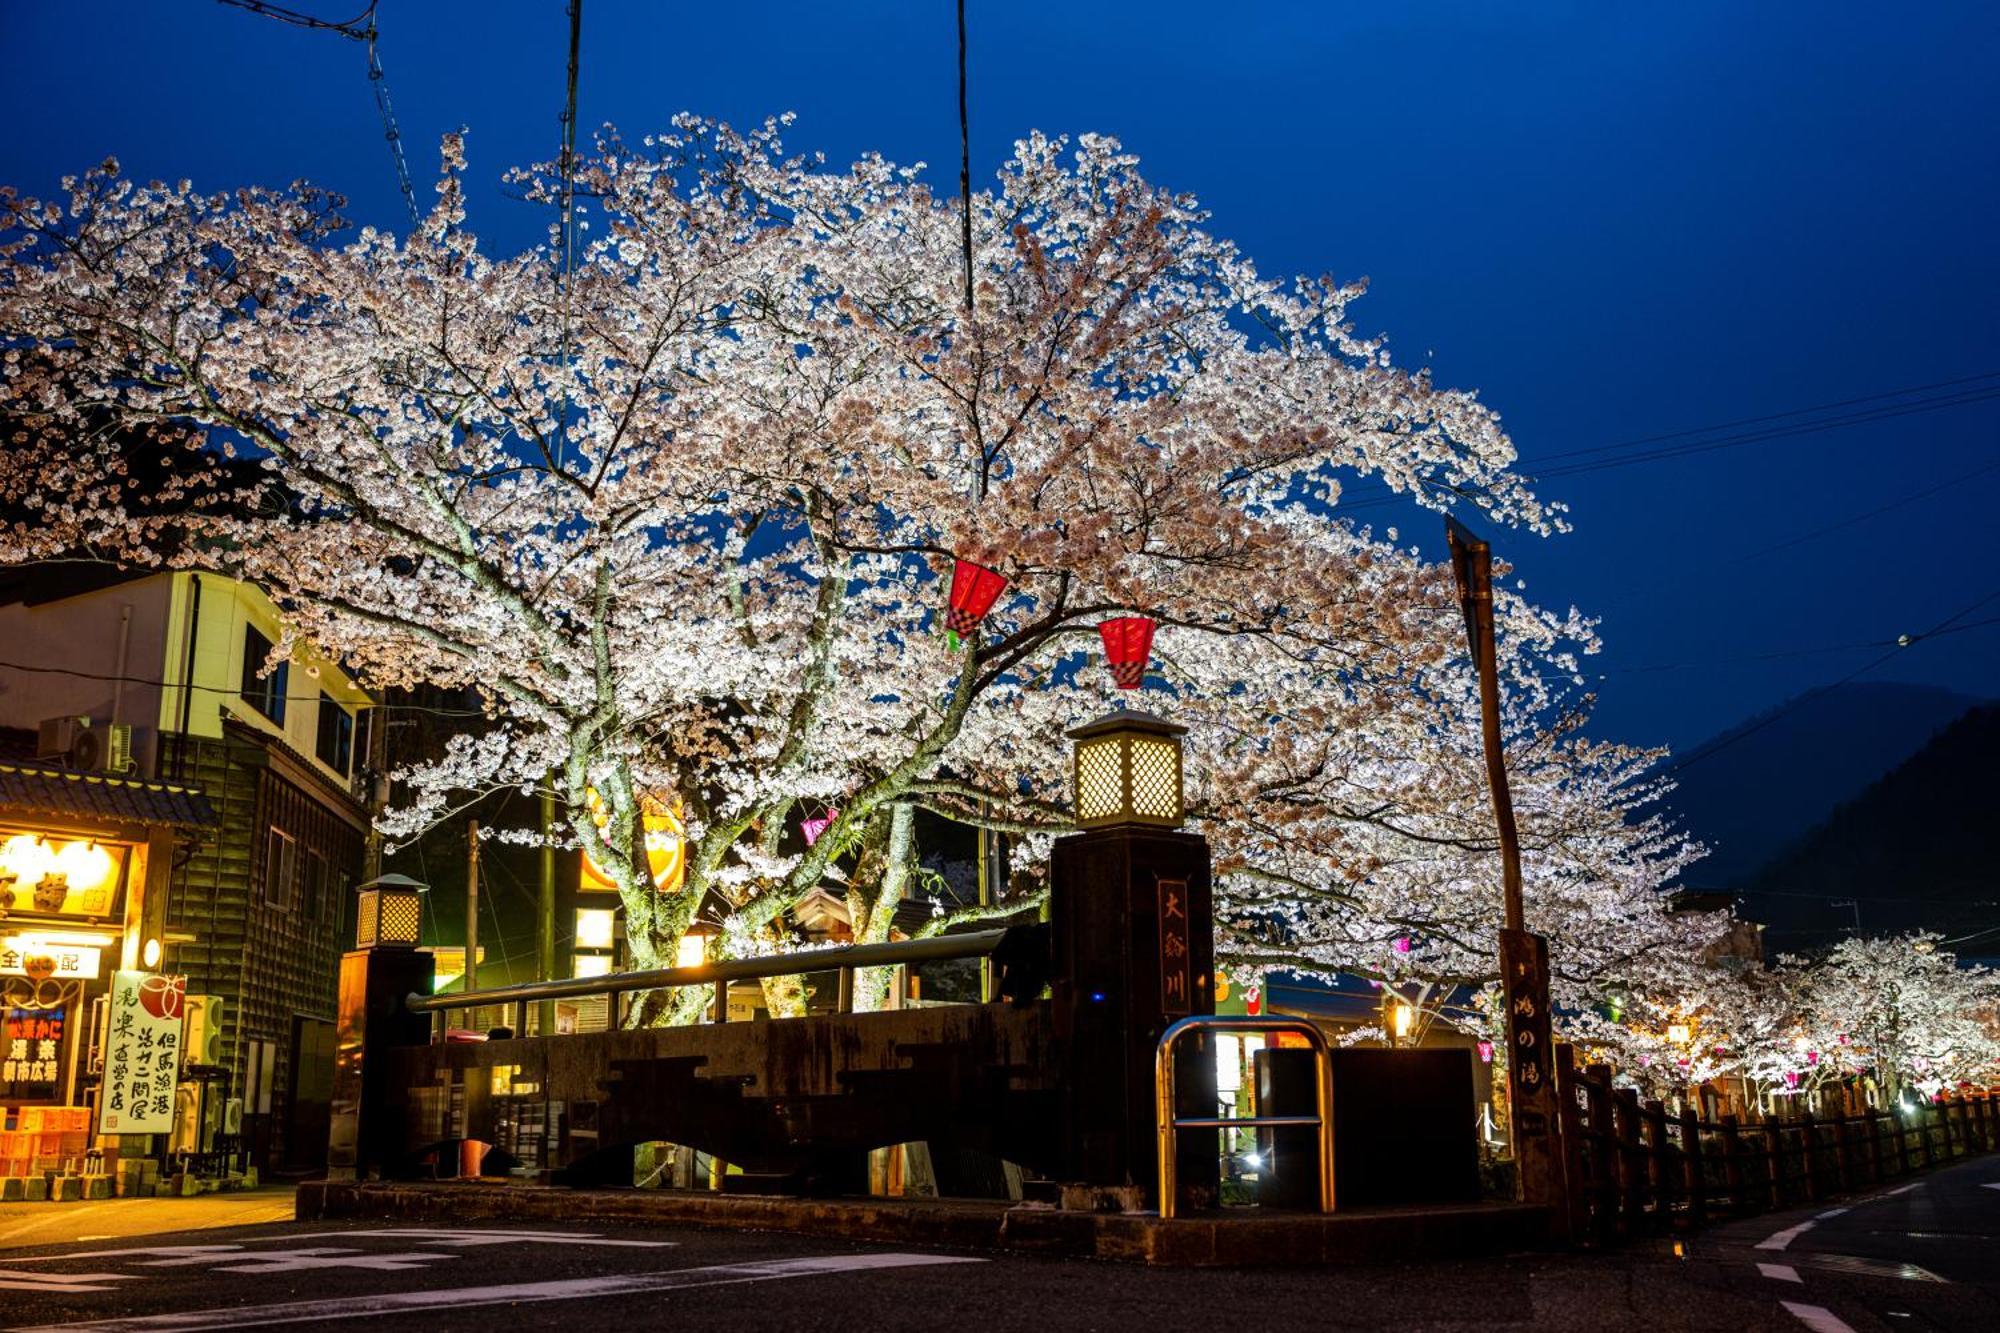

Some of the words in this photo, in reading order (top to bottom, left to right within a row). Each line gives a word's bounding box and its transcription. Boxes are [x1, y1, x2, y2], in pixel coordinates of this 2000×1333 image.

[129, 1027, 154, 1121] 活カニ問屋
[151, 1032, 177, 1114] 但馬漁港
